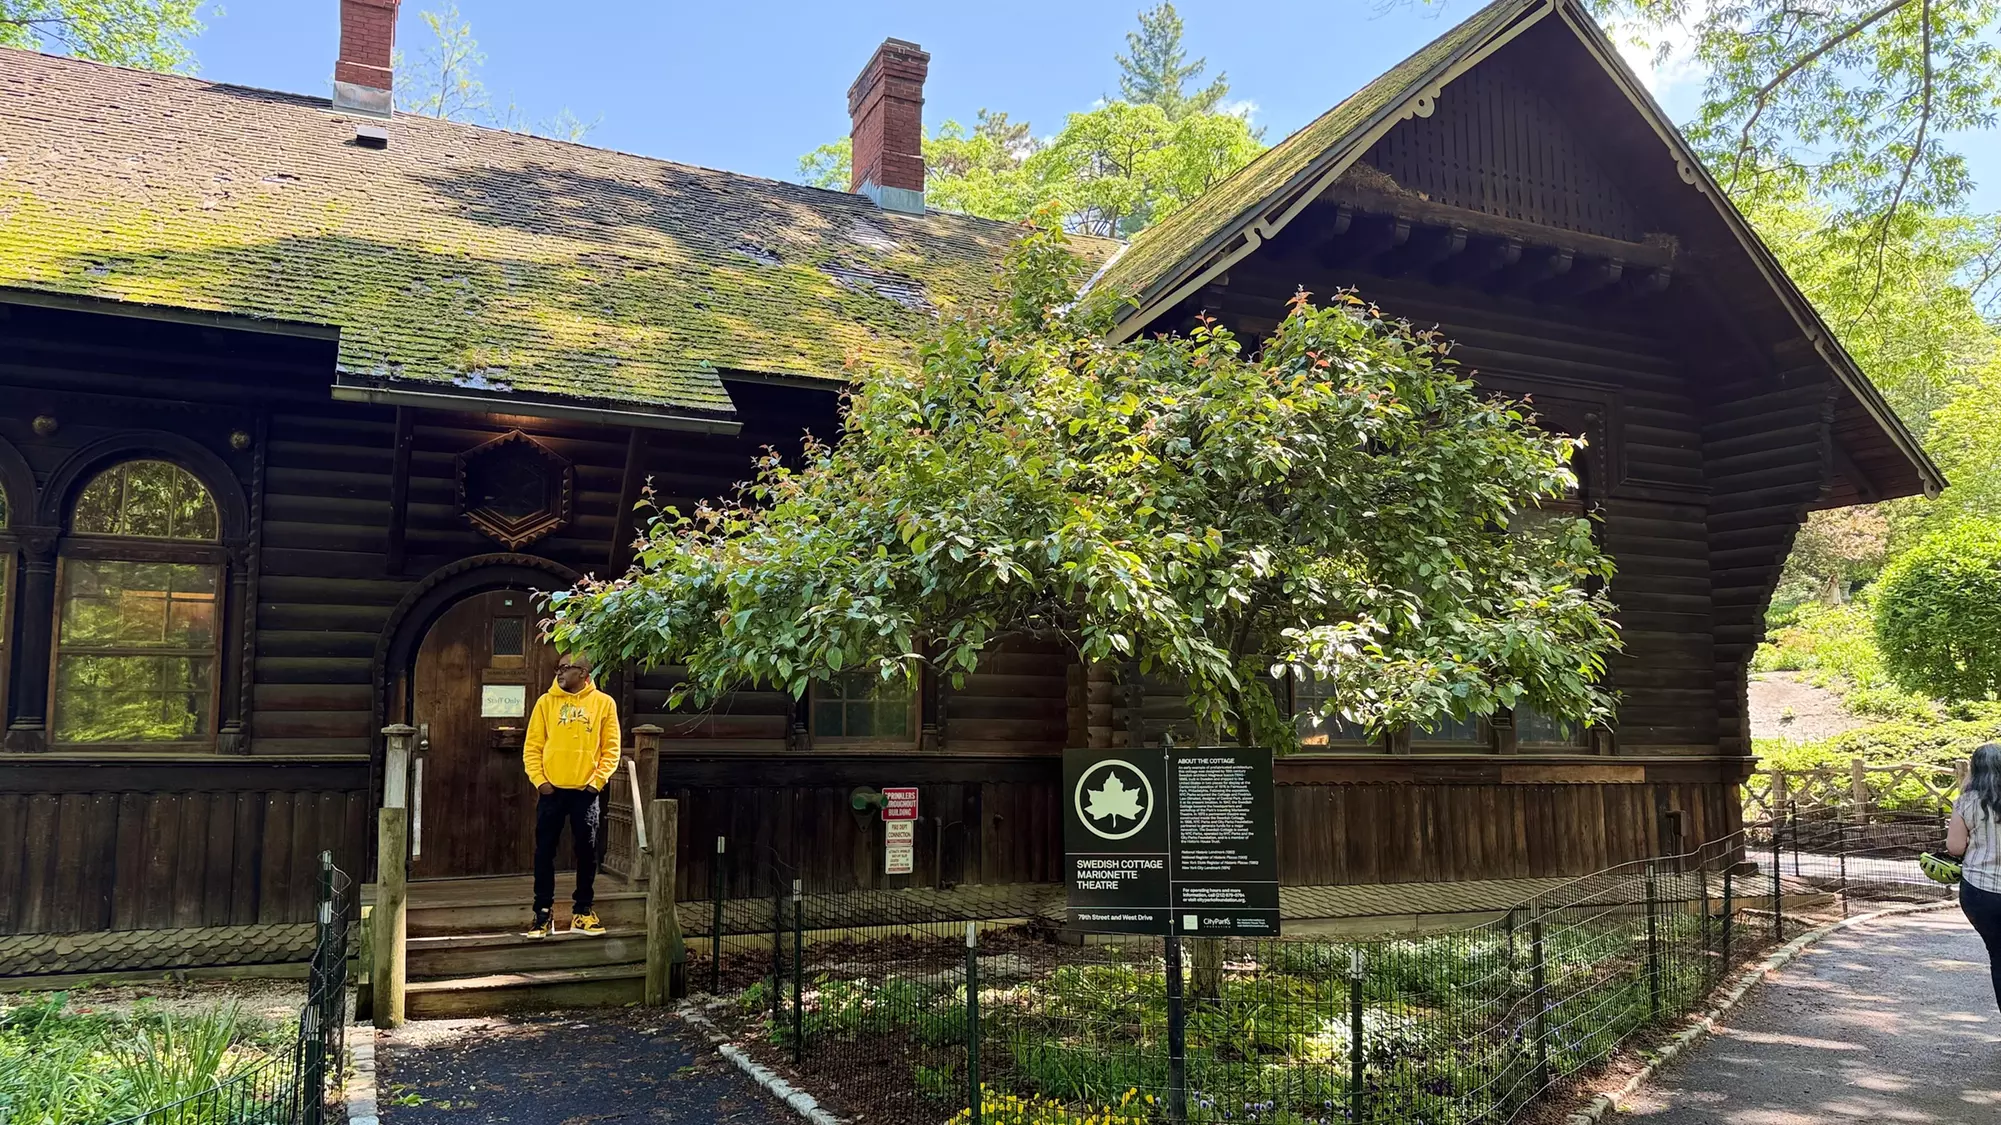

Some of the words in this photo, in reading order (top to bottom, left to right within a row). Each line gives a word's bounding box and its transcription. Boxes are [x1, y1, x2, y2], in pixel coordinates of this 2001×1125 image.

[504, 697, 520, 705] Only
[1076, 860, 1119, 868] SWEDISH
[1121, 860, 1163, 868] COTTAGE
[1077, 870, 1138, 879] MARIONETTE
[1076, 881, 1119, 889] THEATRE
